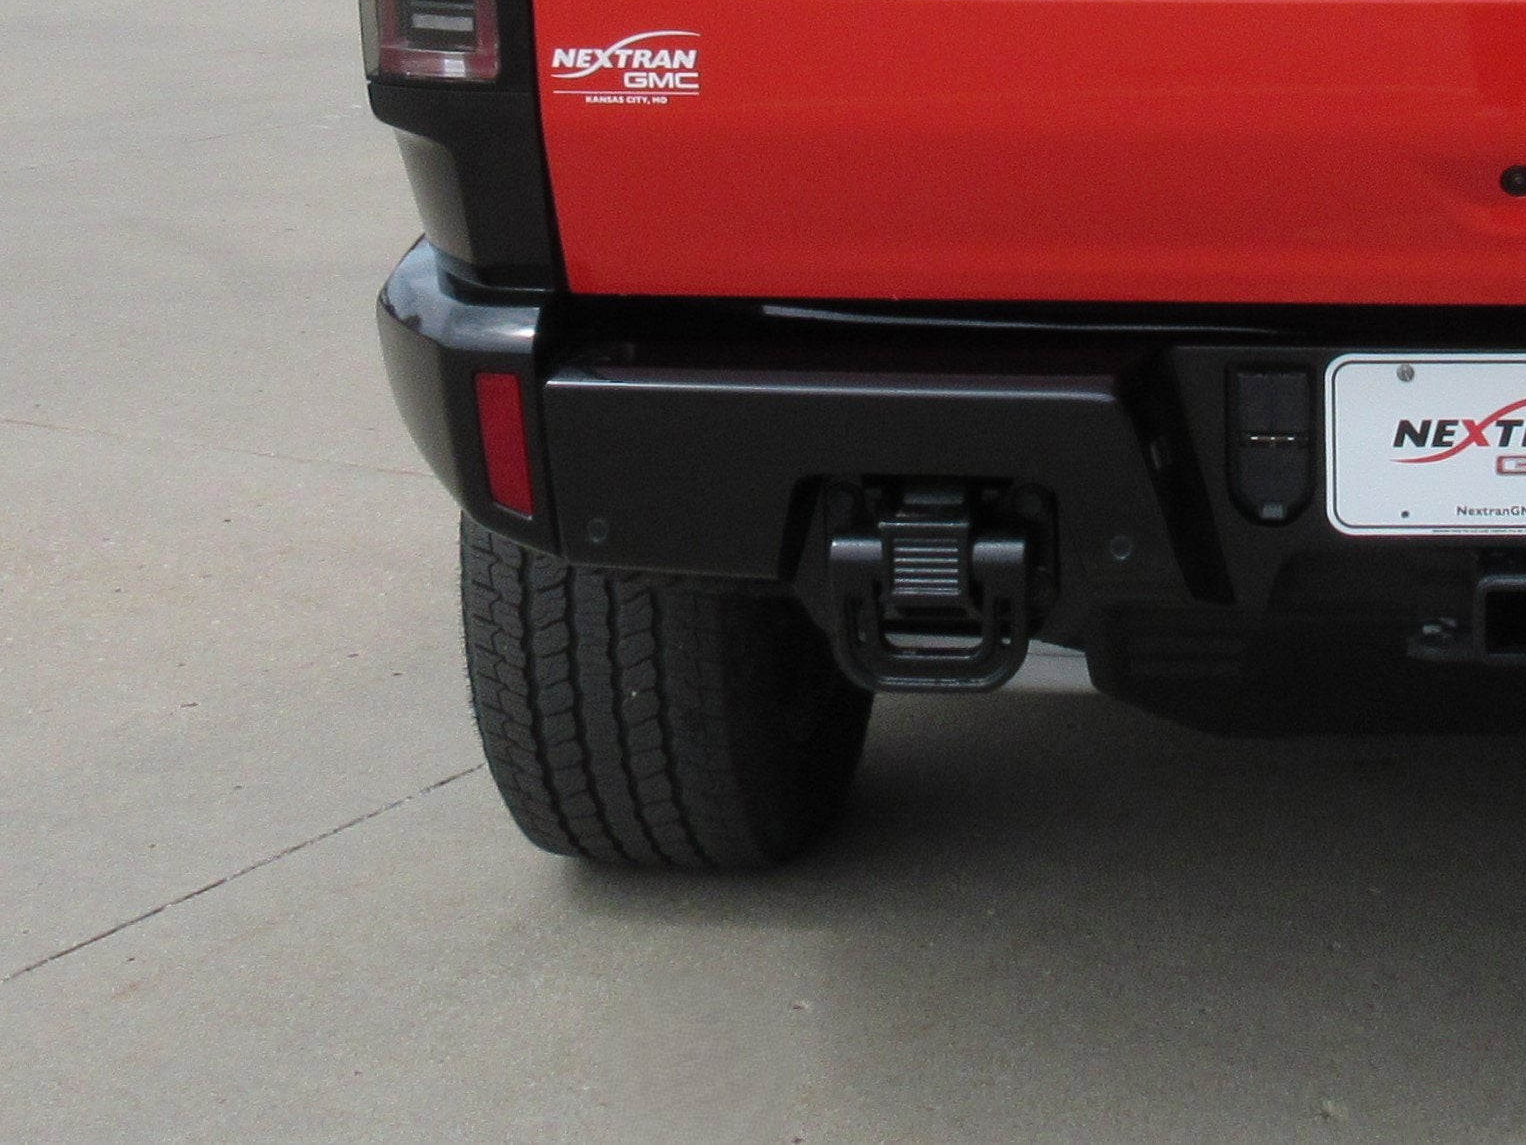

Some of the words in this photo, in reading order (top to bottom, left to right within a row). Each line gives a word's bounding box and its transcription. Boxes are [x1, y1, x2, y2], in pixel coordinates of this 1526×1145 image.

[551, 48, 698, 69] NEXTRAN
[623, 71, 700, 89] GMC
[585, 95, 625, 104] KANSAS
[625, 95, 651, 105] CITY,
[651, 95, 668, 104] MO
